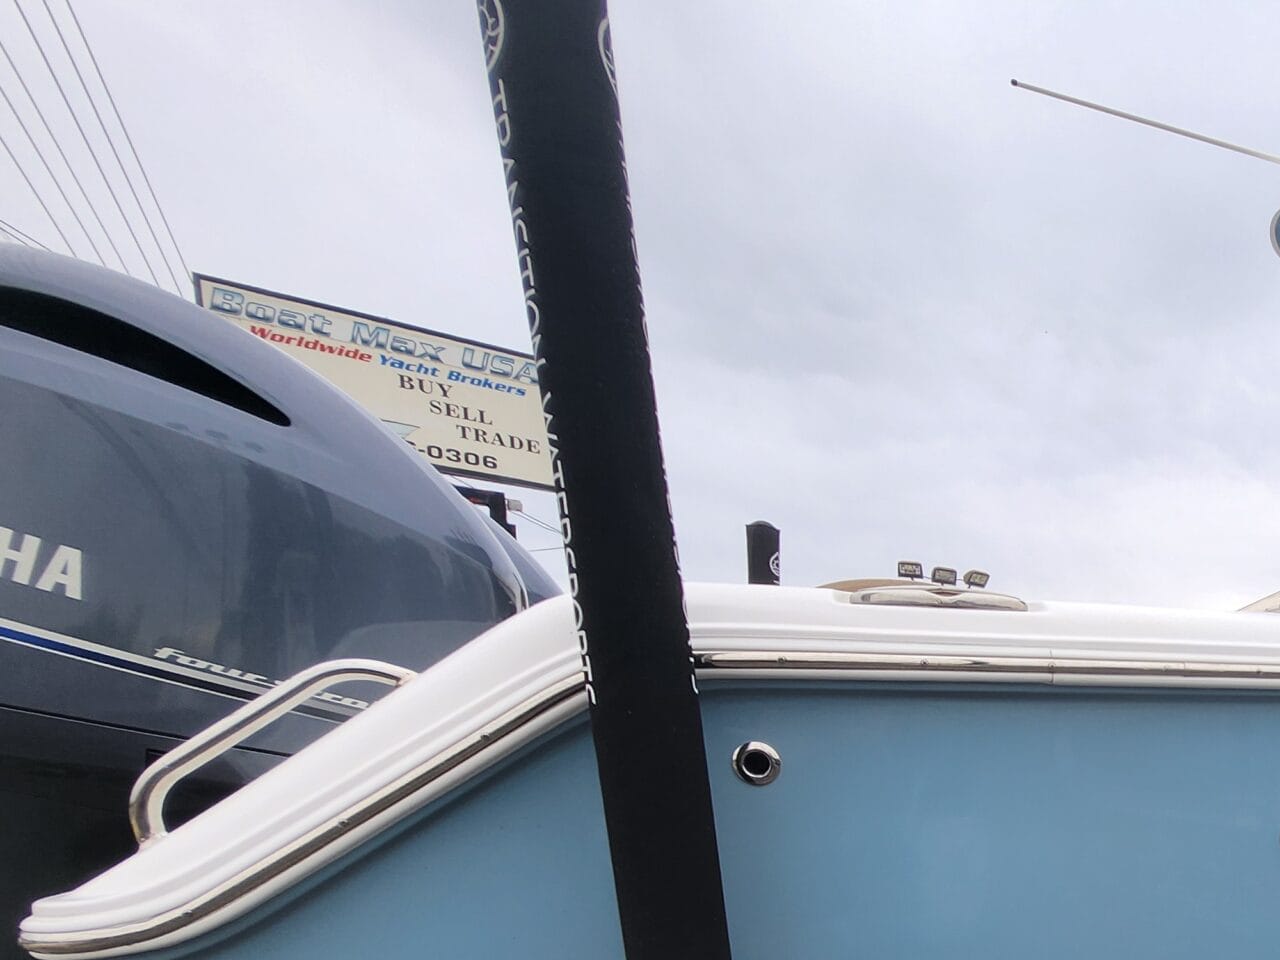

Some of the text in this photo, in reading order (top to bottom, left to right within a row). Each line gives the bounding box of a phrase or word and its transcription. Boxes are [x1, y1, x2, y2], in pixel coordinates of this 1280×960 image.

[210, 287, 539, 385] Boat Max USA
[250, 325, 527, 397] Worldwide Yacht Brokers
[397, 373, 454, 399] BUY
[429, 400, 493, 426] SELL
[456, 424, 541, 455] TRADE
